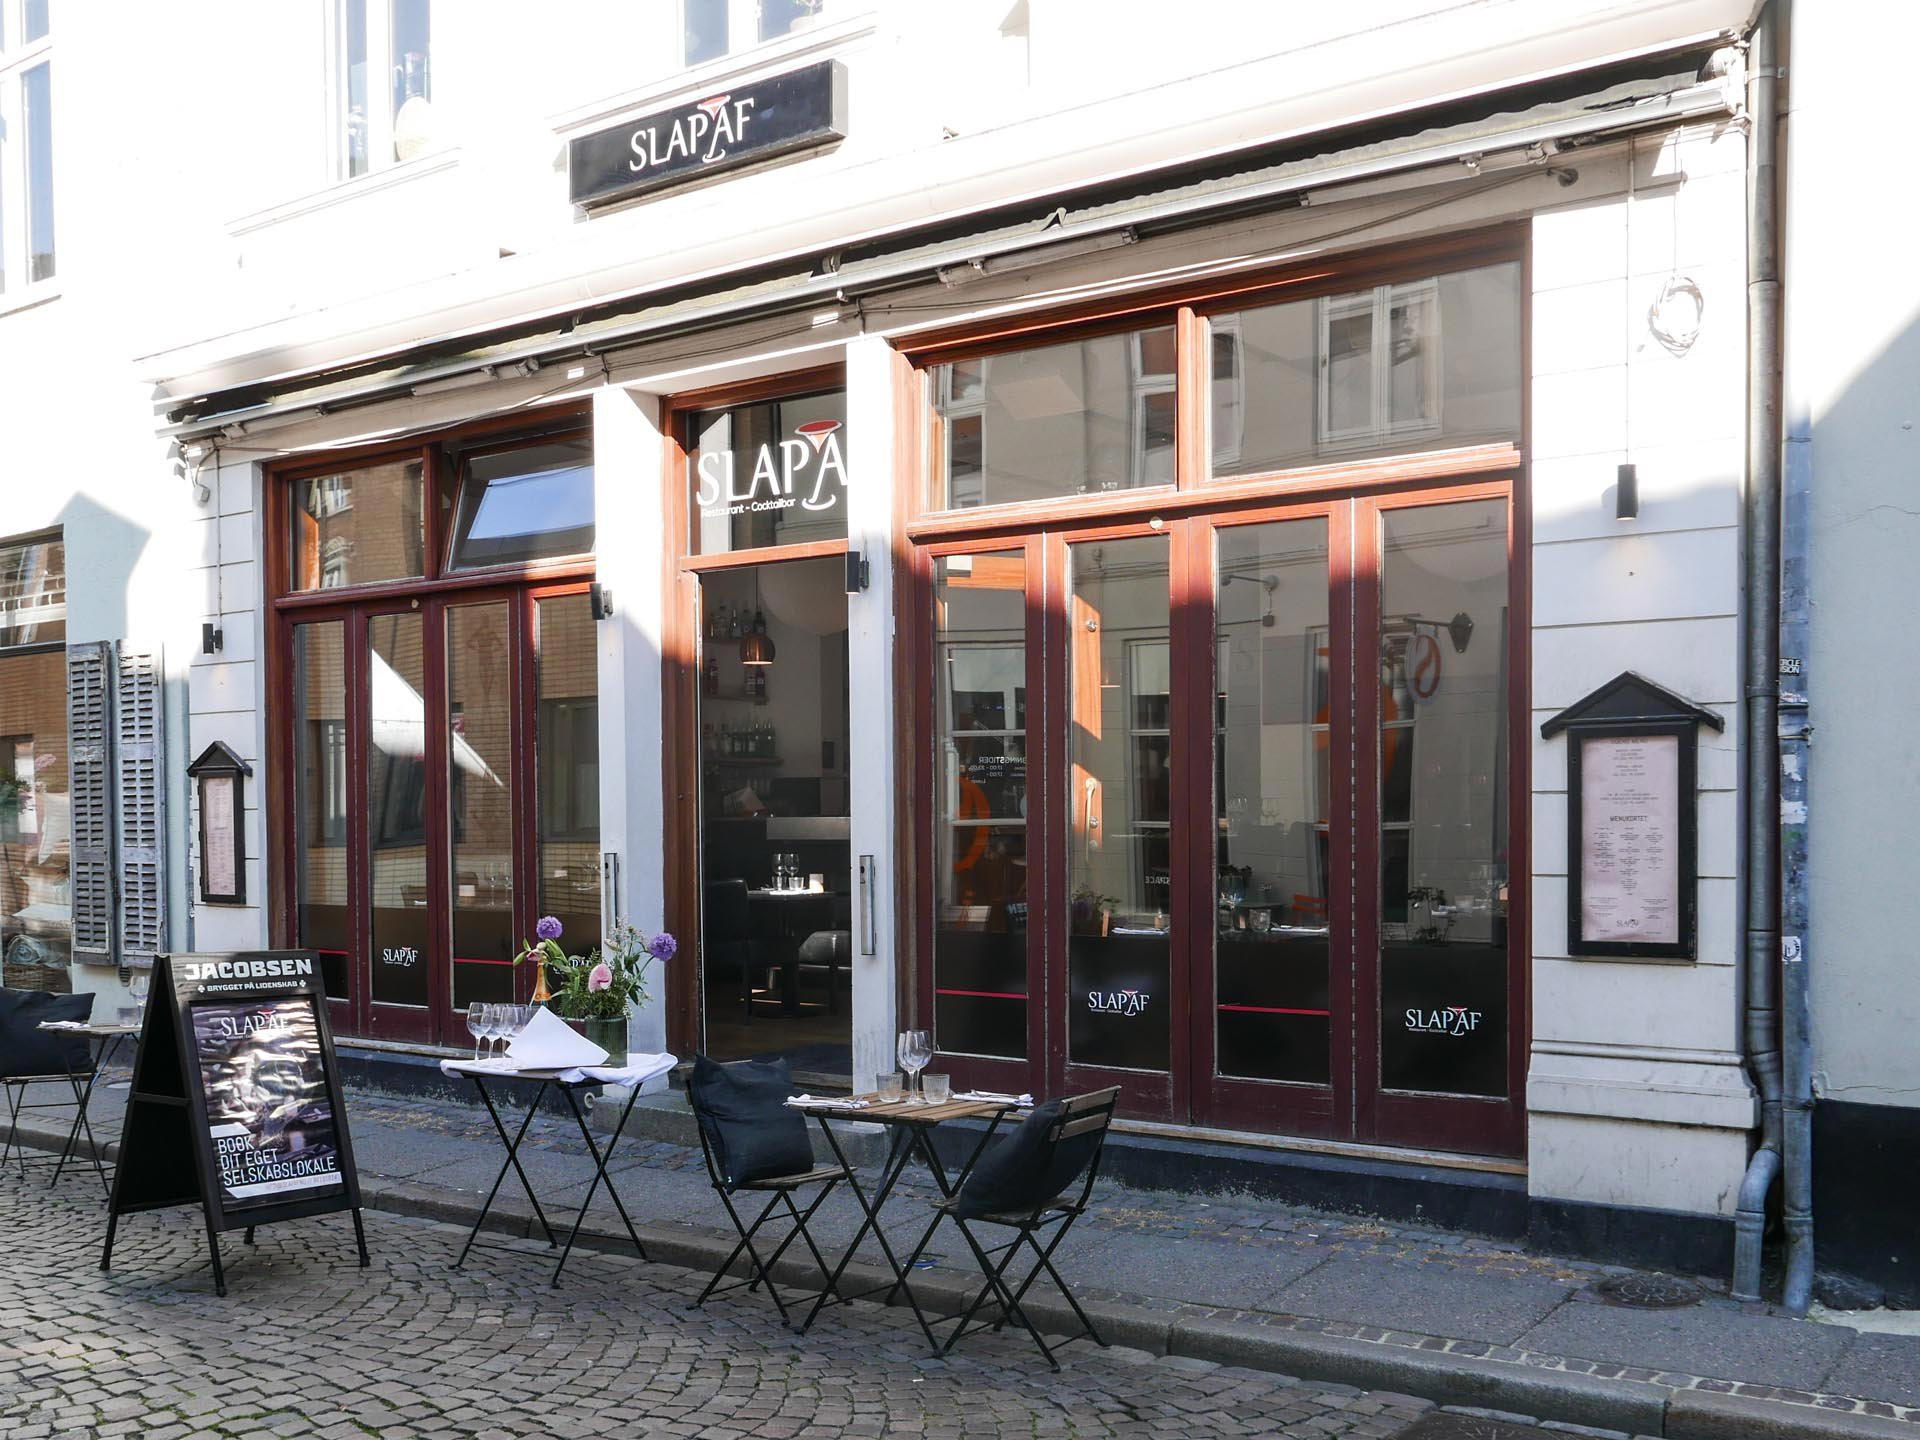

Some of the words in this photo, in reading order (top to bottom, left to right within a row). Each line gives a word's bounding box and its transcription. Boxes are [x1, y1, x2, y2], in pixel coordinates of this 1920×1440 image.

[629, 96, 755, 172] SLAPAF
[751, 498, 796, 512] Cocktailbar
[383, 947, 418, 966] SLAPAF
[184, 959, 312, 981] JACOBSEN
[207, 983, 243, 992] BRYGGET
[244, 981, 255, 990] PÅ
[255, 980, 298, 990] LIDENSKAB
[1088, 990, 1150, 1017] SLAPAF
[1405, 1007, 1482, 1036] SLAPAF
[218, 1135, 255, 1154] BOOK
[220, 1153, 241, 1170] DIT
[245, 1148, 278, 1167] EGET
[223, 1156, 336, 1187] SELSKABSLOKALE
